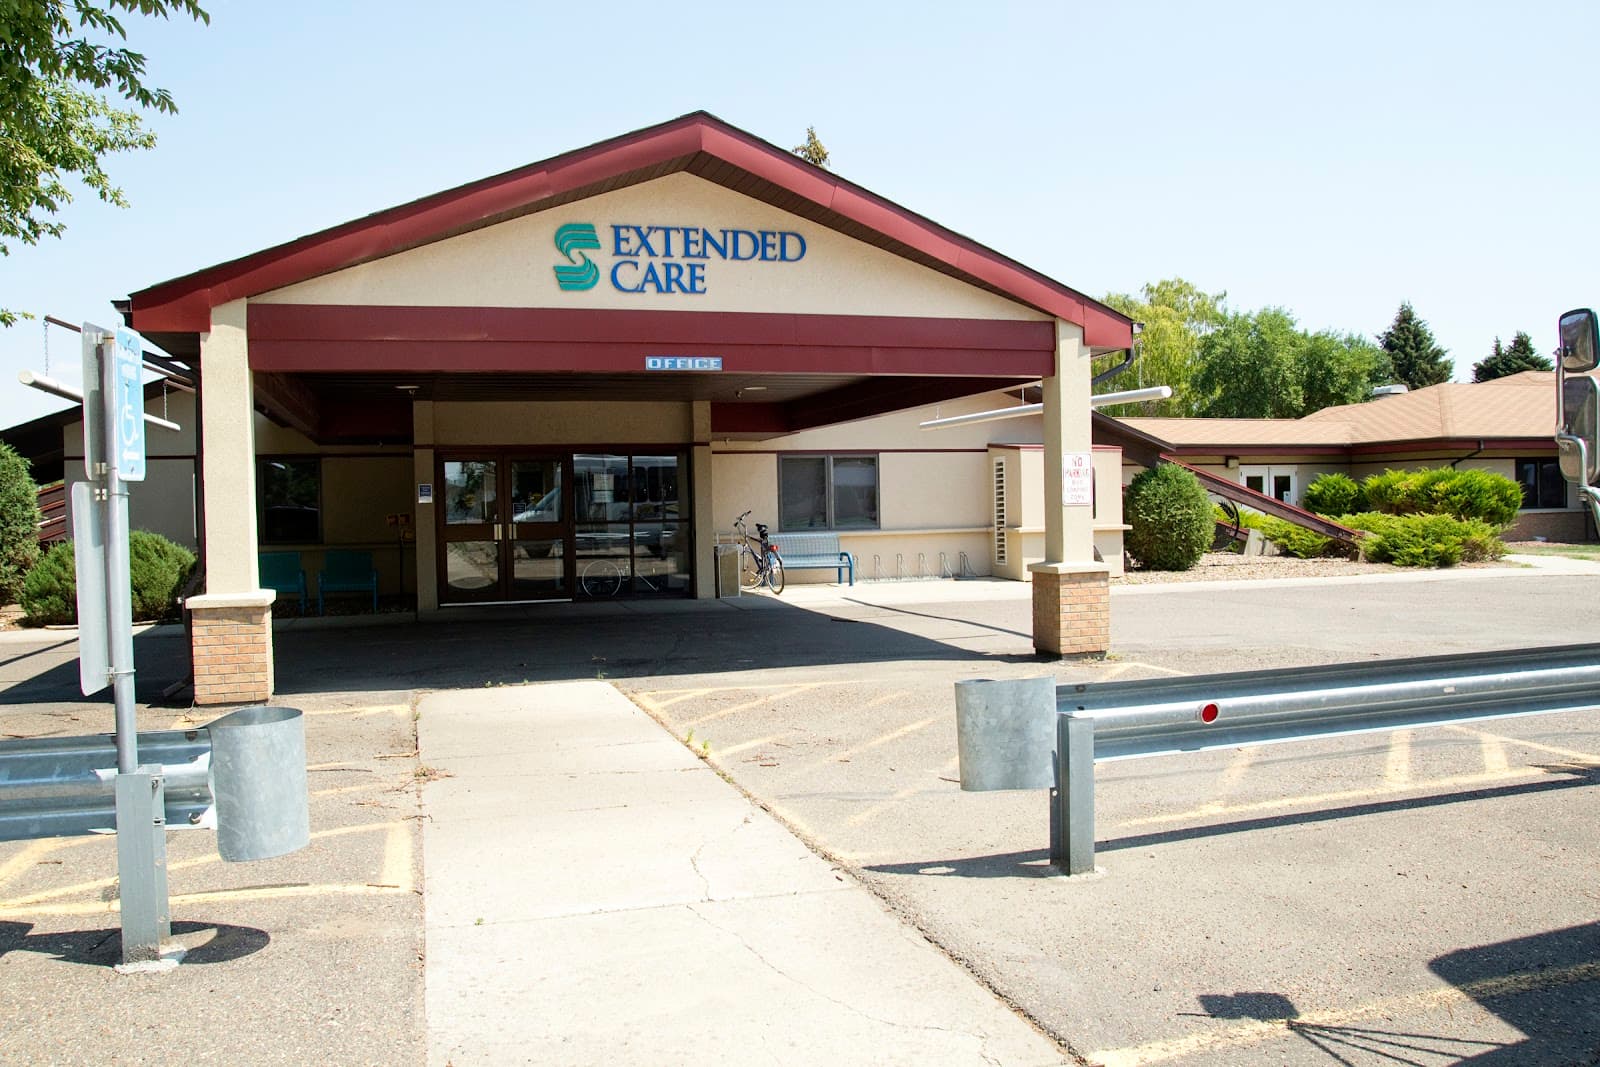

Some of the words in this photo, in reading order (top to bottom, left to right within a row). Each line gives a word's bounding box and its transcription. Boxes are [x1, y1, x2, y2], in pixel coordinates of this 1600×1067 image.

[610, 224, 807, 262] EXTENDED
[610, 260, 707, 294] CARE
[647, 358, 721, 370] OFFICE
